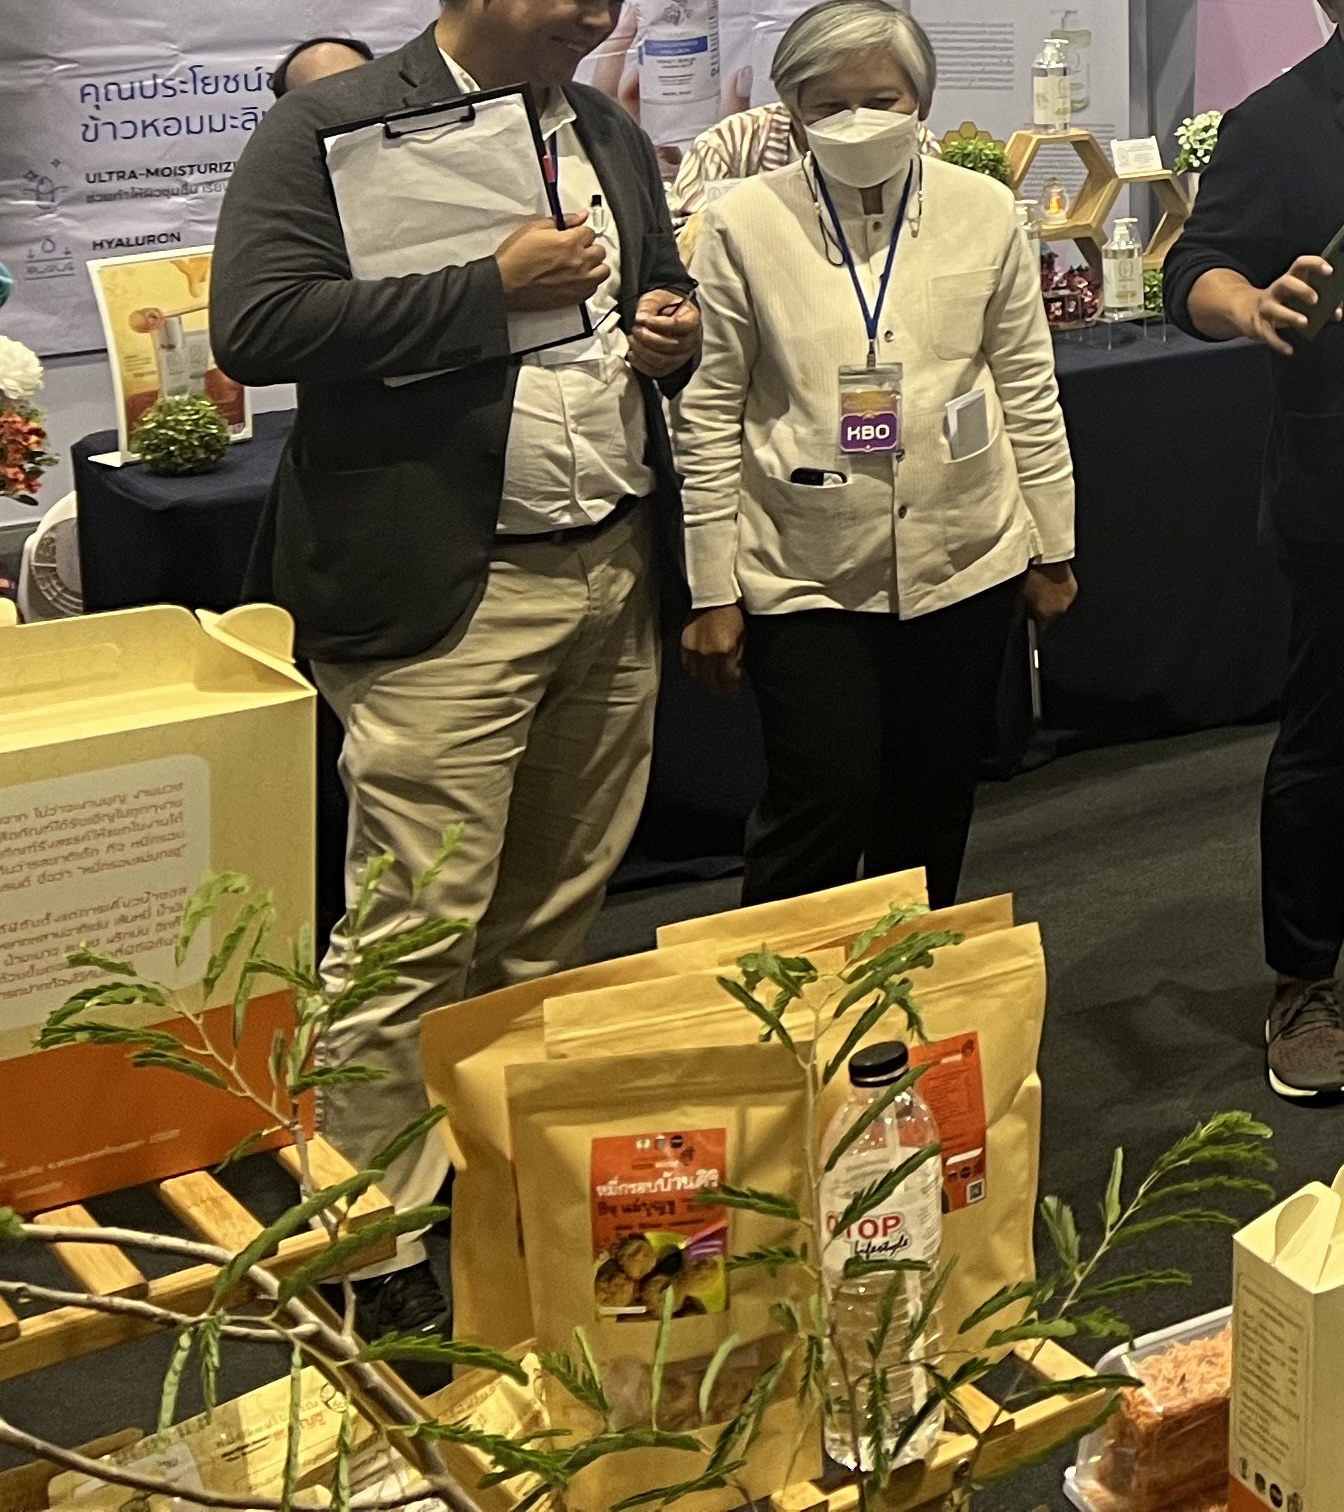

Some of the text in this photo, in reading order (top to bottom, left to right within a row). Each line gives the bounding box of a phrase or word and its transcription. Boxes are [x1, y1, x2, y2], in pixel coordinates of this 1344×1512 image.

[81, 107, 266, 143] ข้าวหอมมะลิ
[85, 161, 236, 184] ULTRA-MOISTURIZ
[92, 231, 181, 251] HYALURON
[847, 424, 890, 442] KBO
[827, 1214, 902, 1240] OOP
